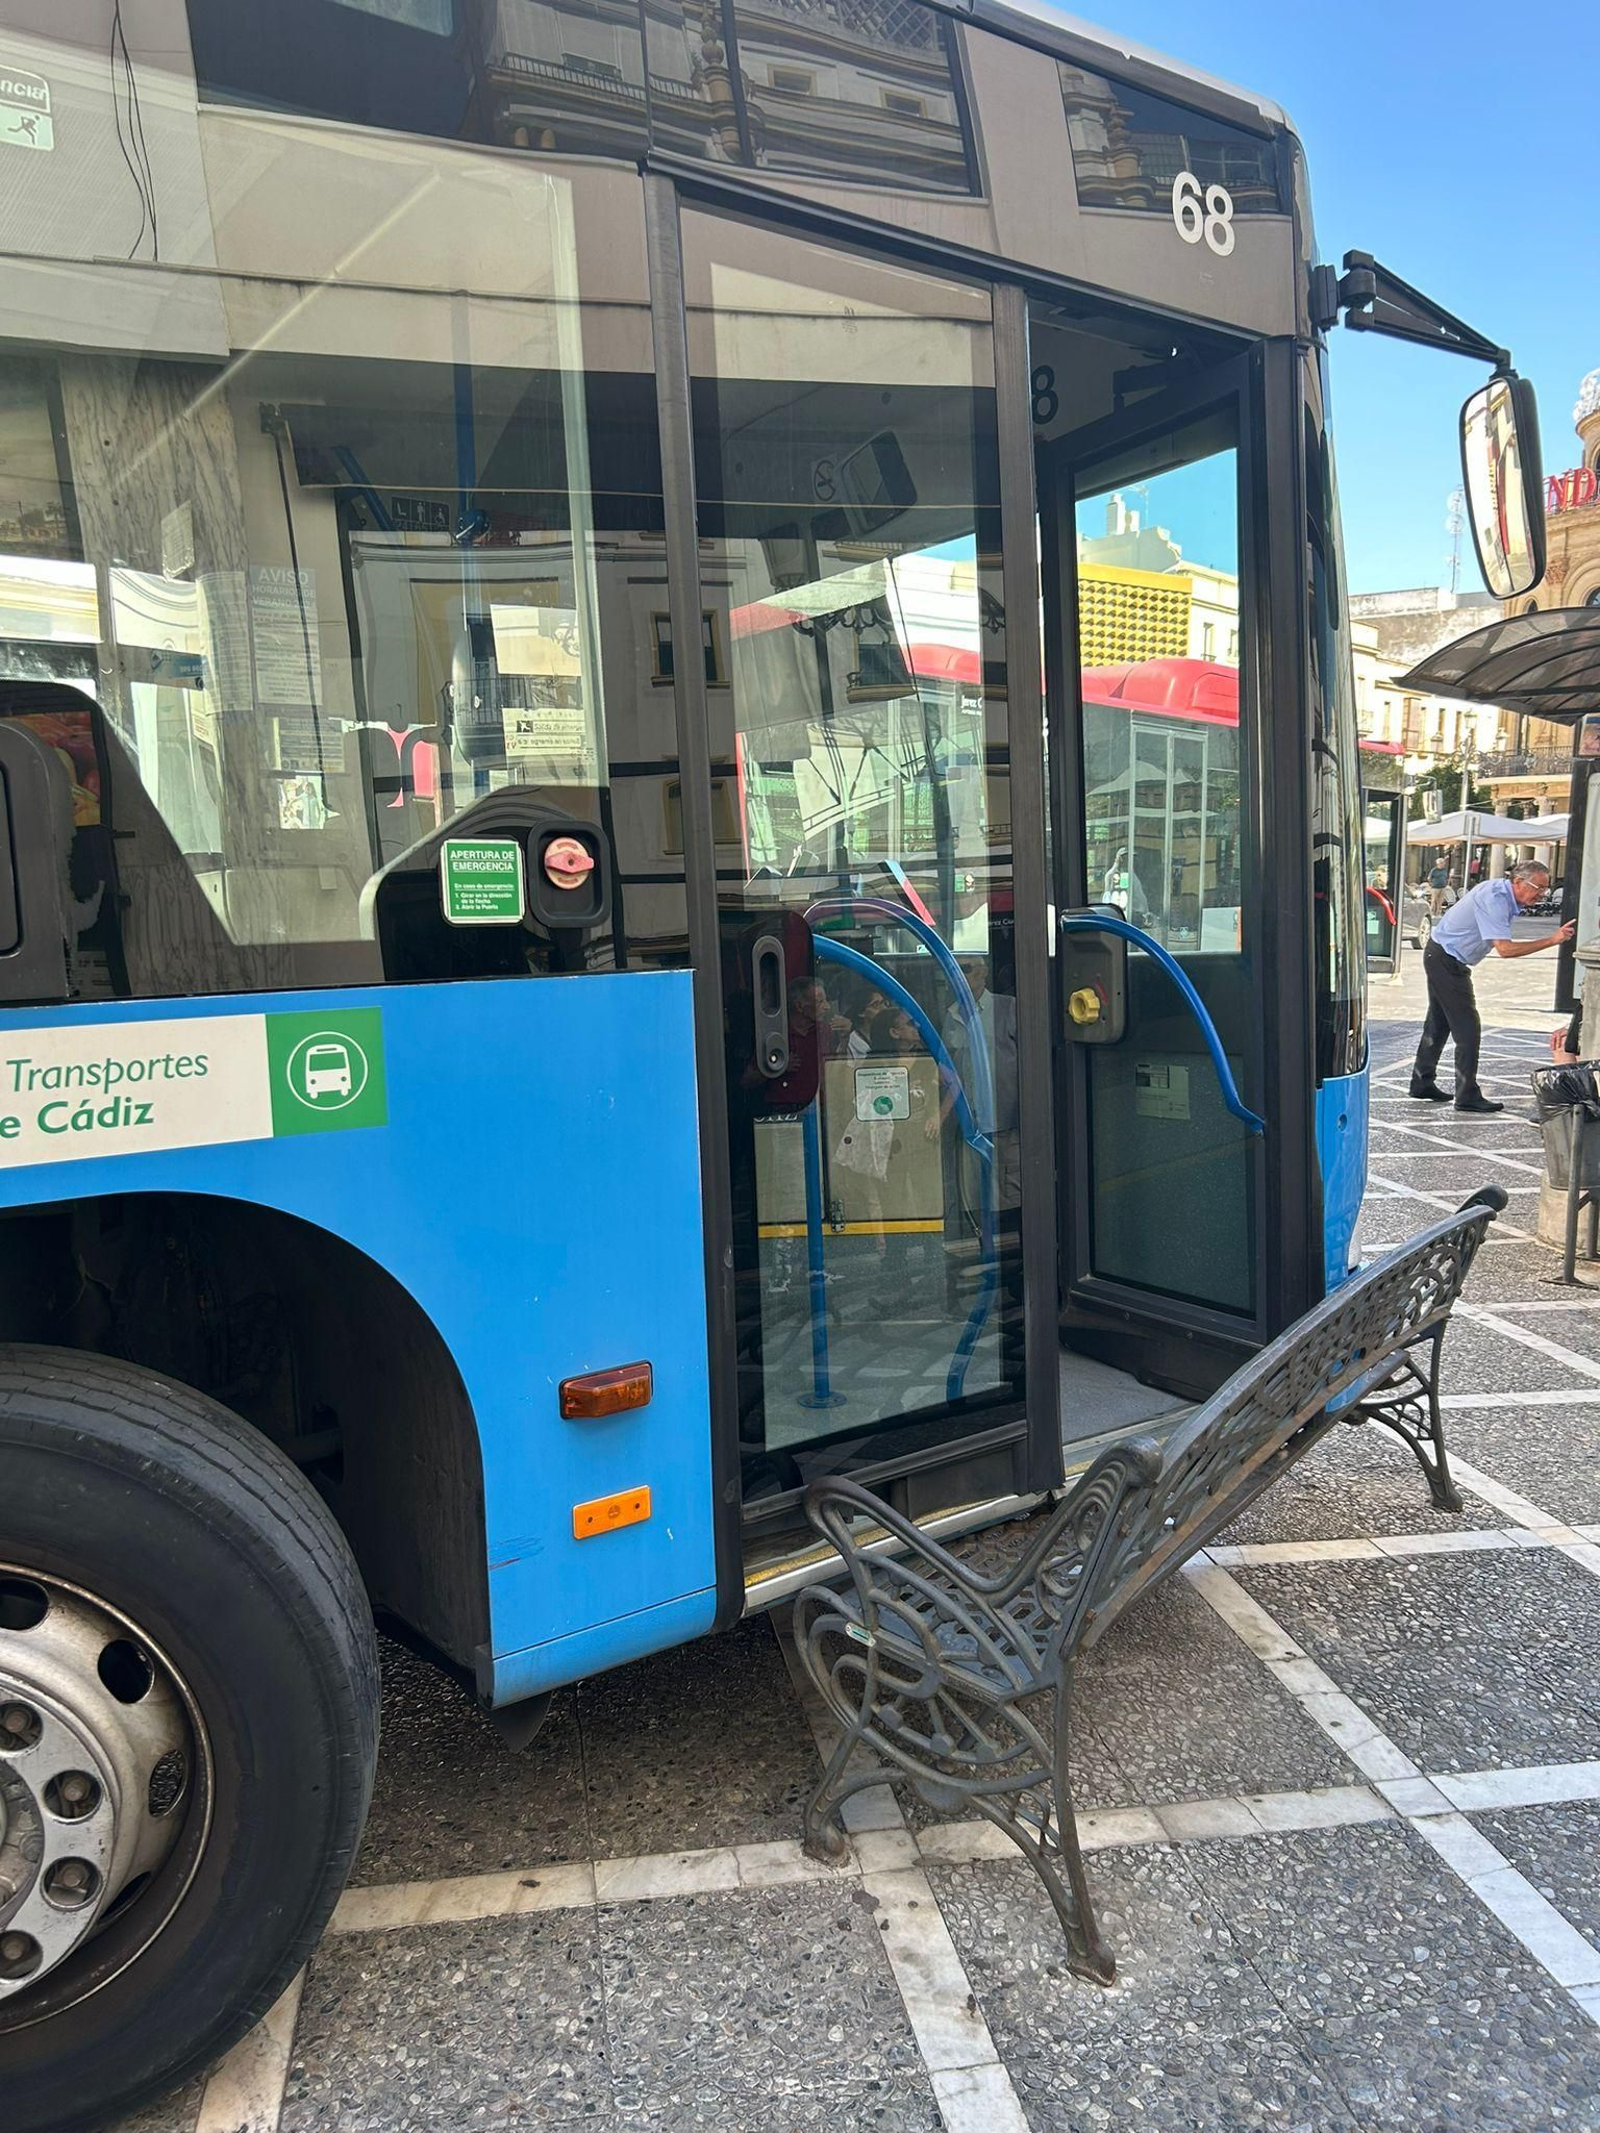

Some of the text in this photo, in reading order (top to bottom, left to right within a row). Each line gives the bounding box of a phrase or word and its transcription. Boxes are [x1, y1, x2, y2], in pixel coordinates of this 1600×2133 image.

[1172, 171, 1235, 256] 68
[1547, 466, 1600, 513] ND
[259, 568, 309, 585] AVISO
[450, 850, 515, 860] APERTURA DE
[453, 861, 514, 872] EMERGENCIA
[6, 1054, 209, 1094] Transportes
[0, 1096, 154, 1138] e Cádiz
